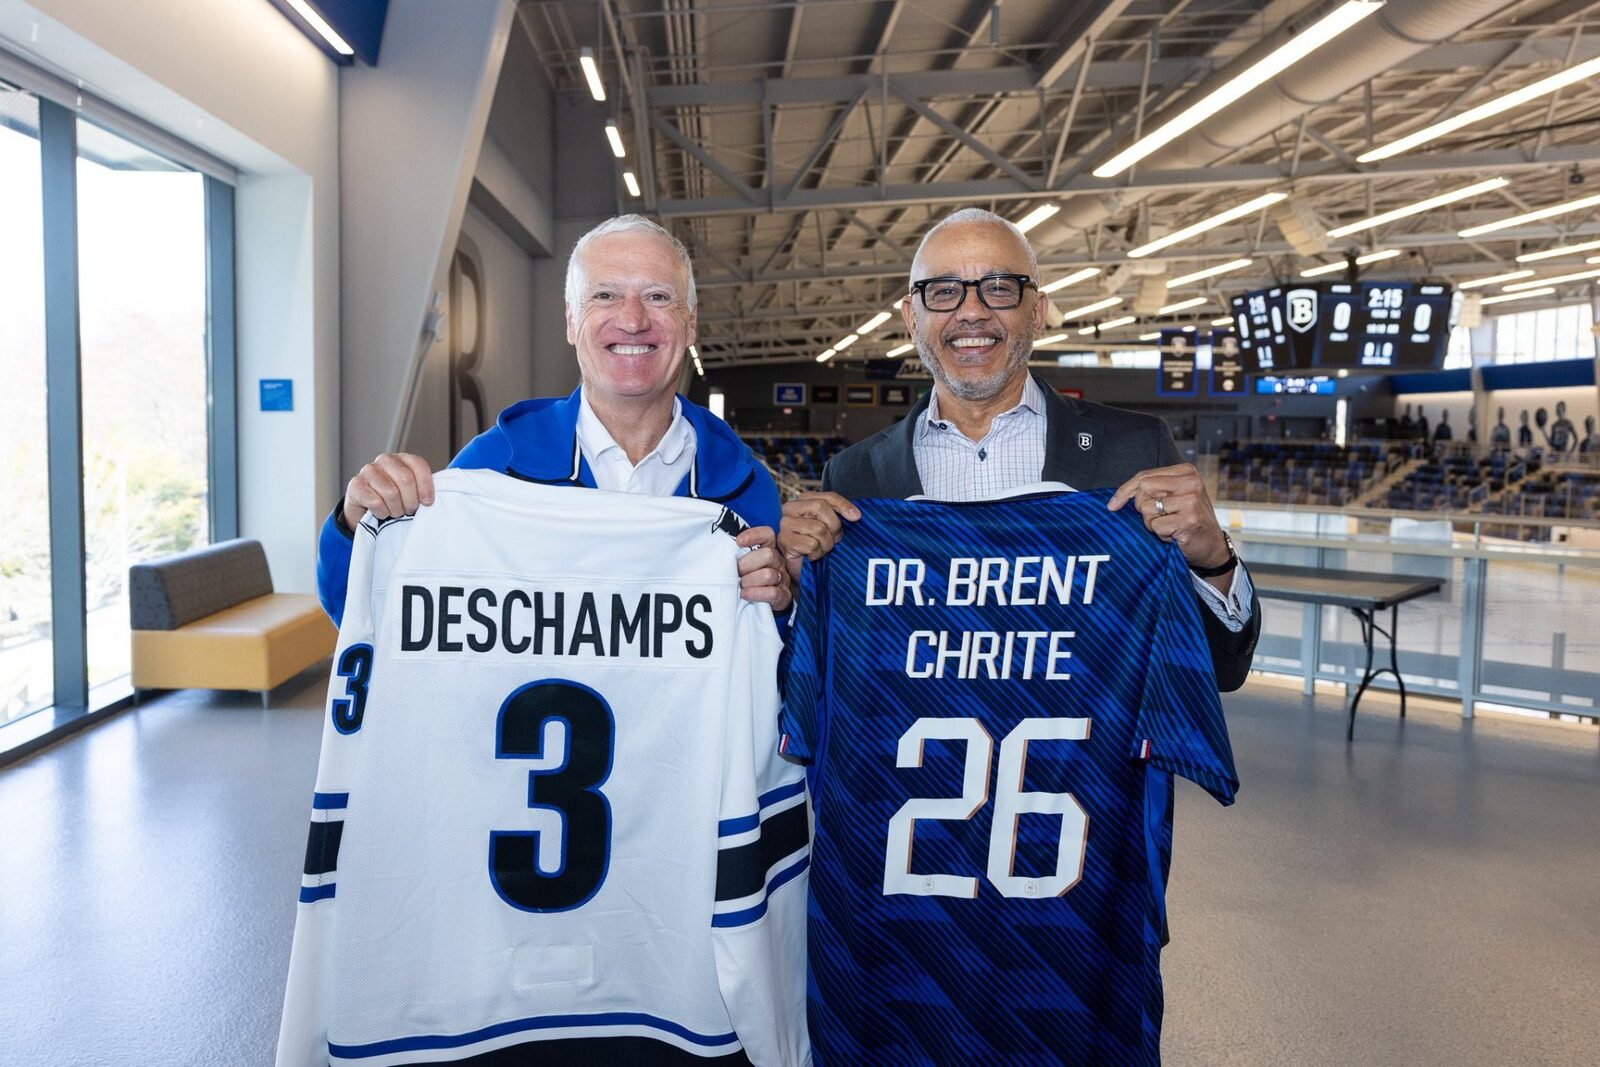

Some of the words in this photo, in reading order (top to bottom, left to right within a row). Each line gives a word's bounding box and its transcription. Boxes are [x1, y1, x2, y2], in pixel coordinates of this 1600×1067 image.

[1291, 298, 1313, 325] B
[1333, 302, 1351, 331] 0
[1368, 287, 1403, 309] 2:15
[1413, 303, 1432, 332] 0
[1080, 436, 1090, 447] B
[865, 558, 935, 607] DR.
[946, 555, 1110, 606] BRENT
[400, 585, 714, 659] DESCHAMPS
[905, 630, 1076, 680] CHRITE
[332, 643, 374, 735] 3
[488, 677, 616, 914] 3
[883, 717, 1092, 899] 26
